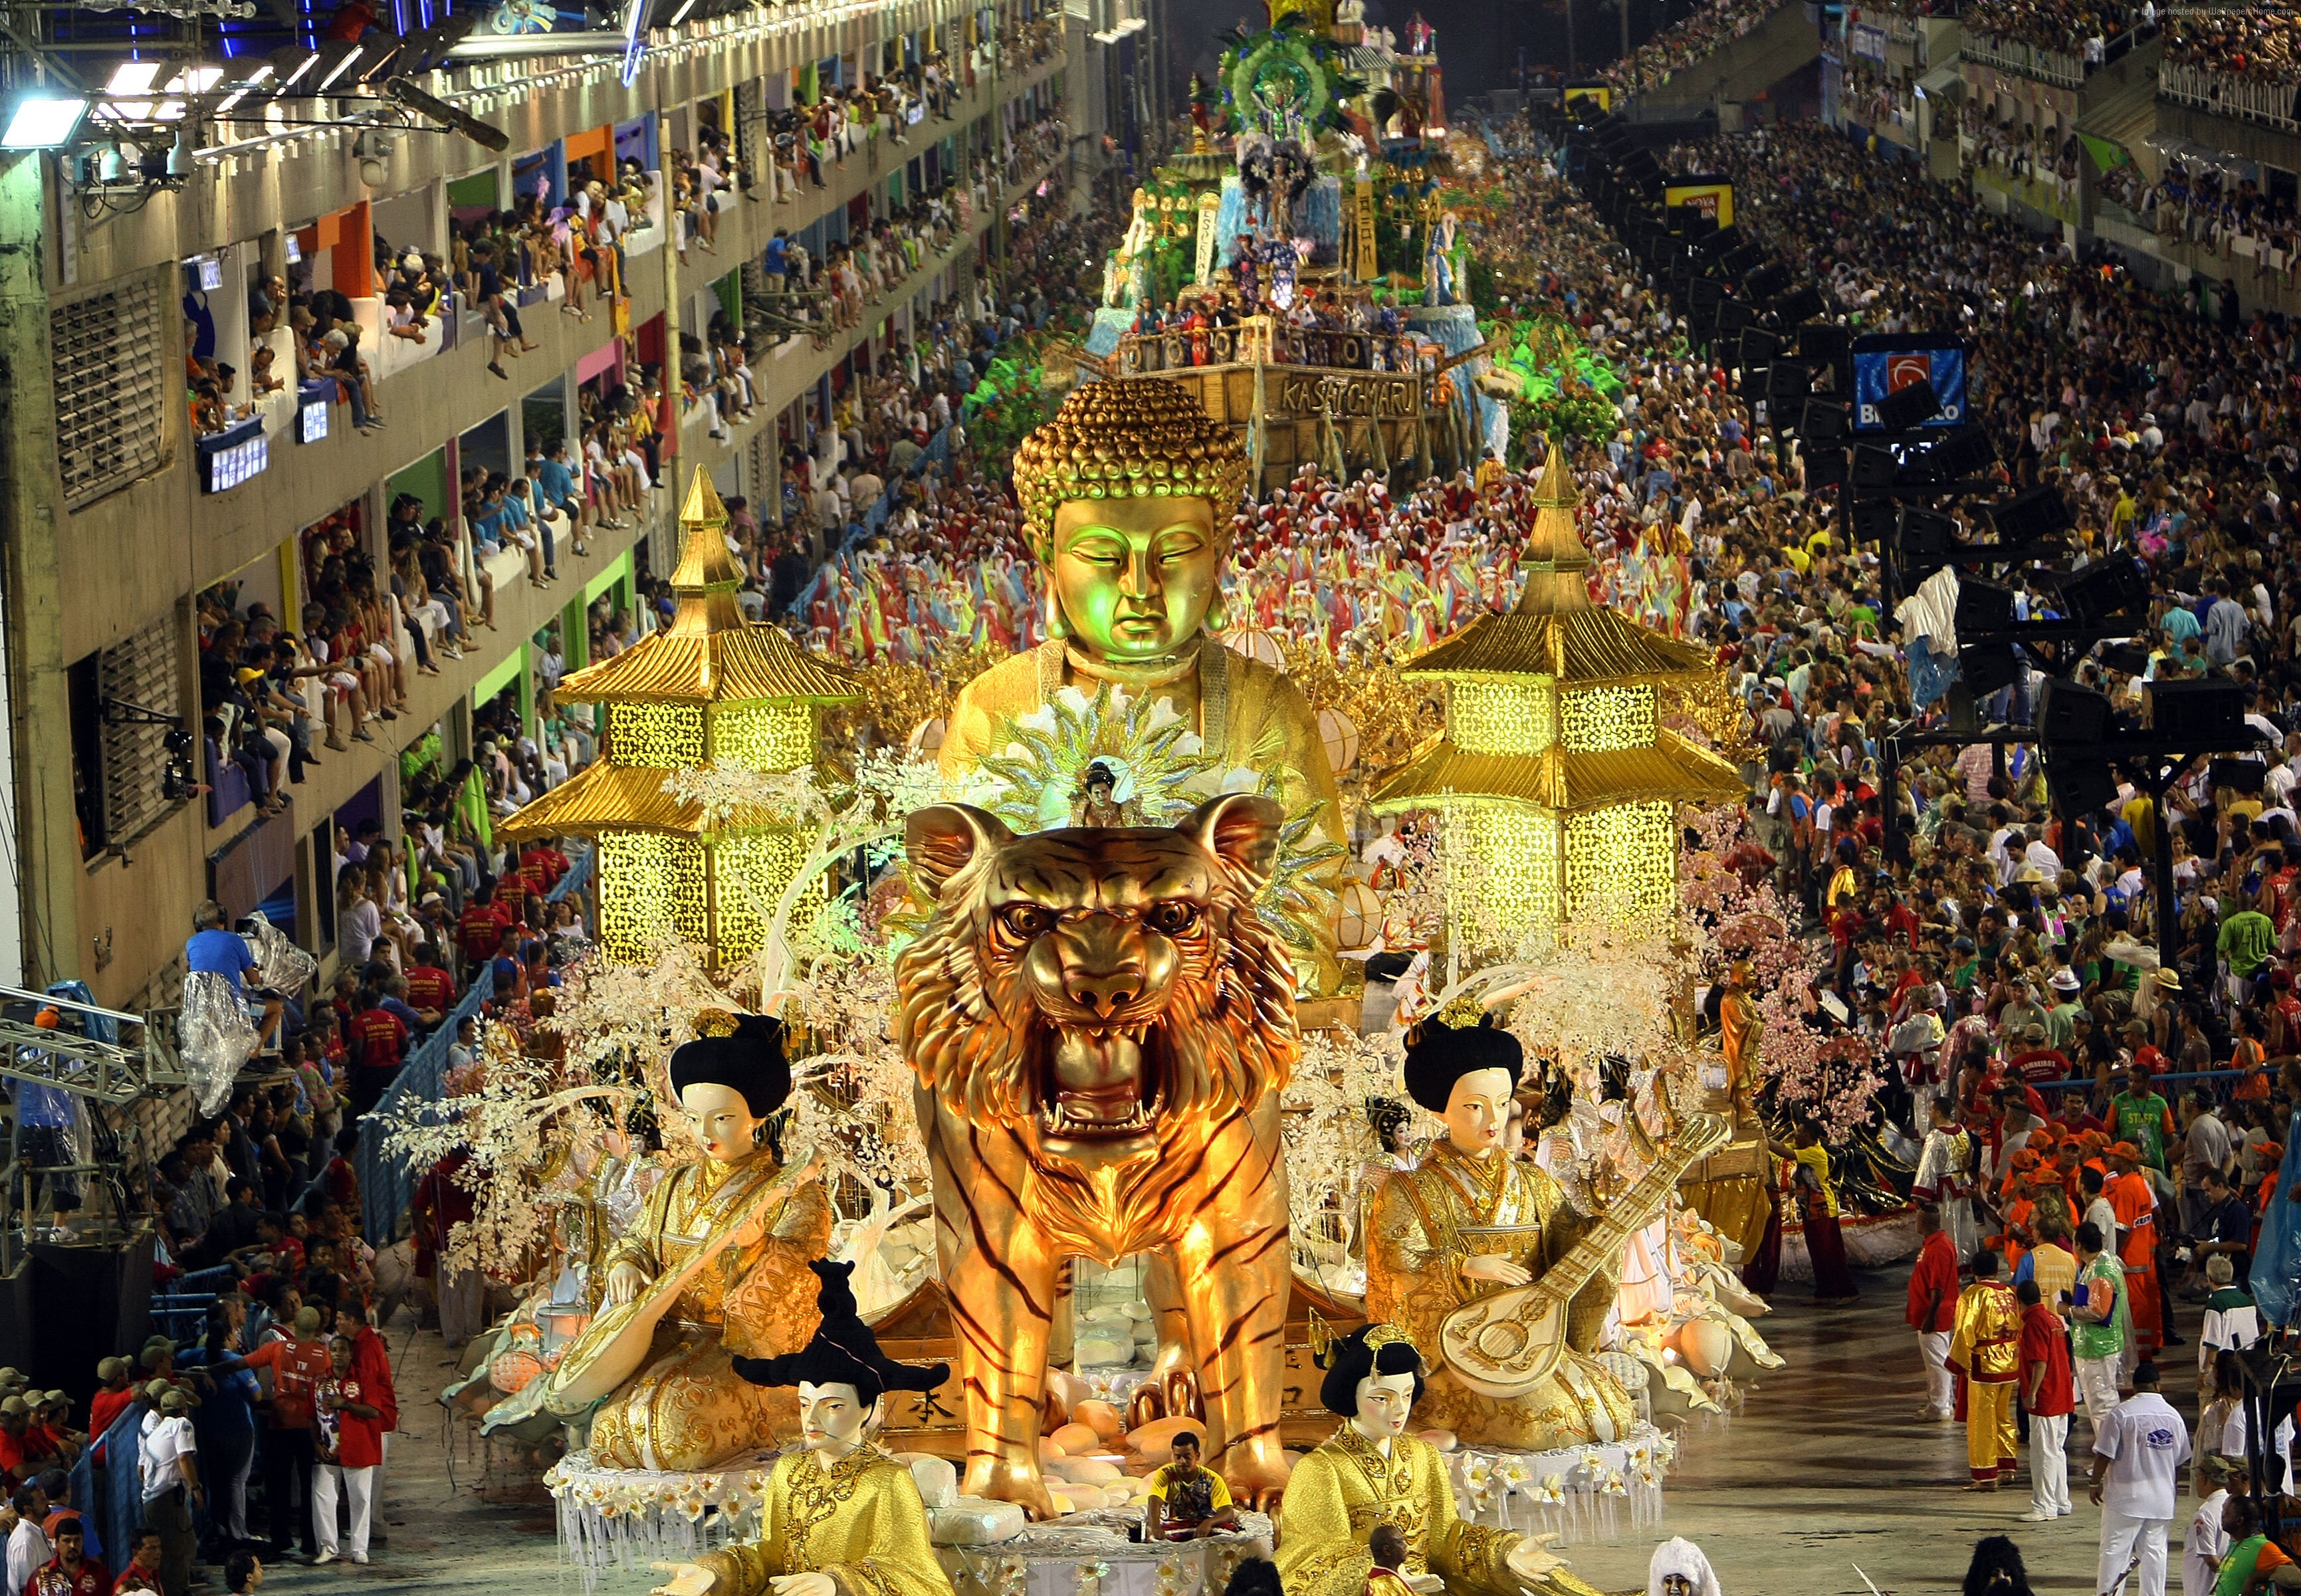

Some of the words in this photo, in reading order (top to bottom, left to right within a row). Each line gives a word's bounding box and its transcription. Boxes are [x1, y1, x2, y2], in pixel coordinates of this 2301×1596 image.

[2062, 550, 2075, 559] 23
[2254, 741, 2270, 750] 25
[2020, 1060, 2056, 1072] BOMBEIROS
[2128, 1112, 2153, 1125] STAFF
